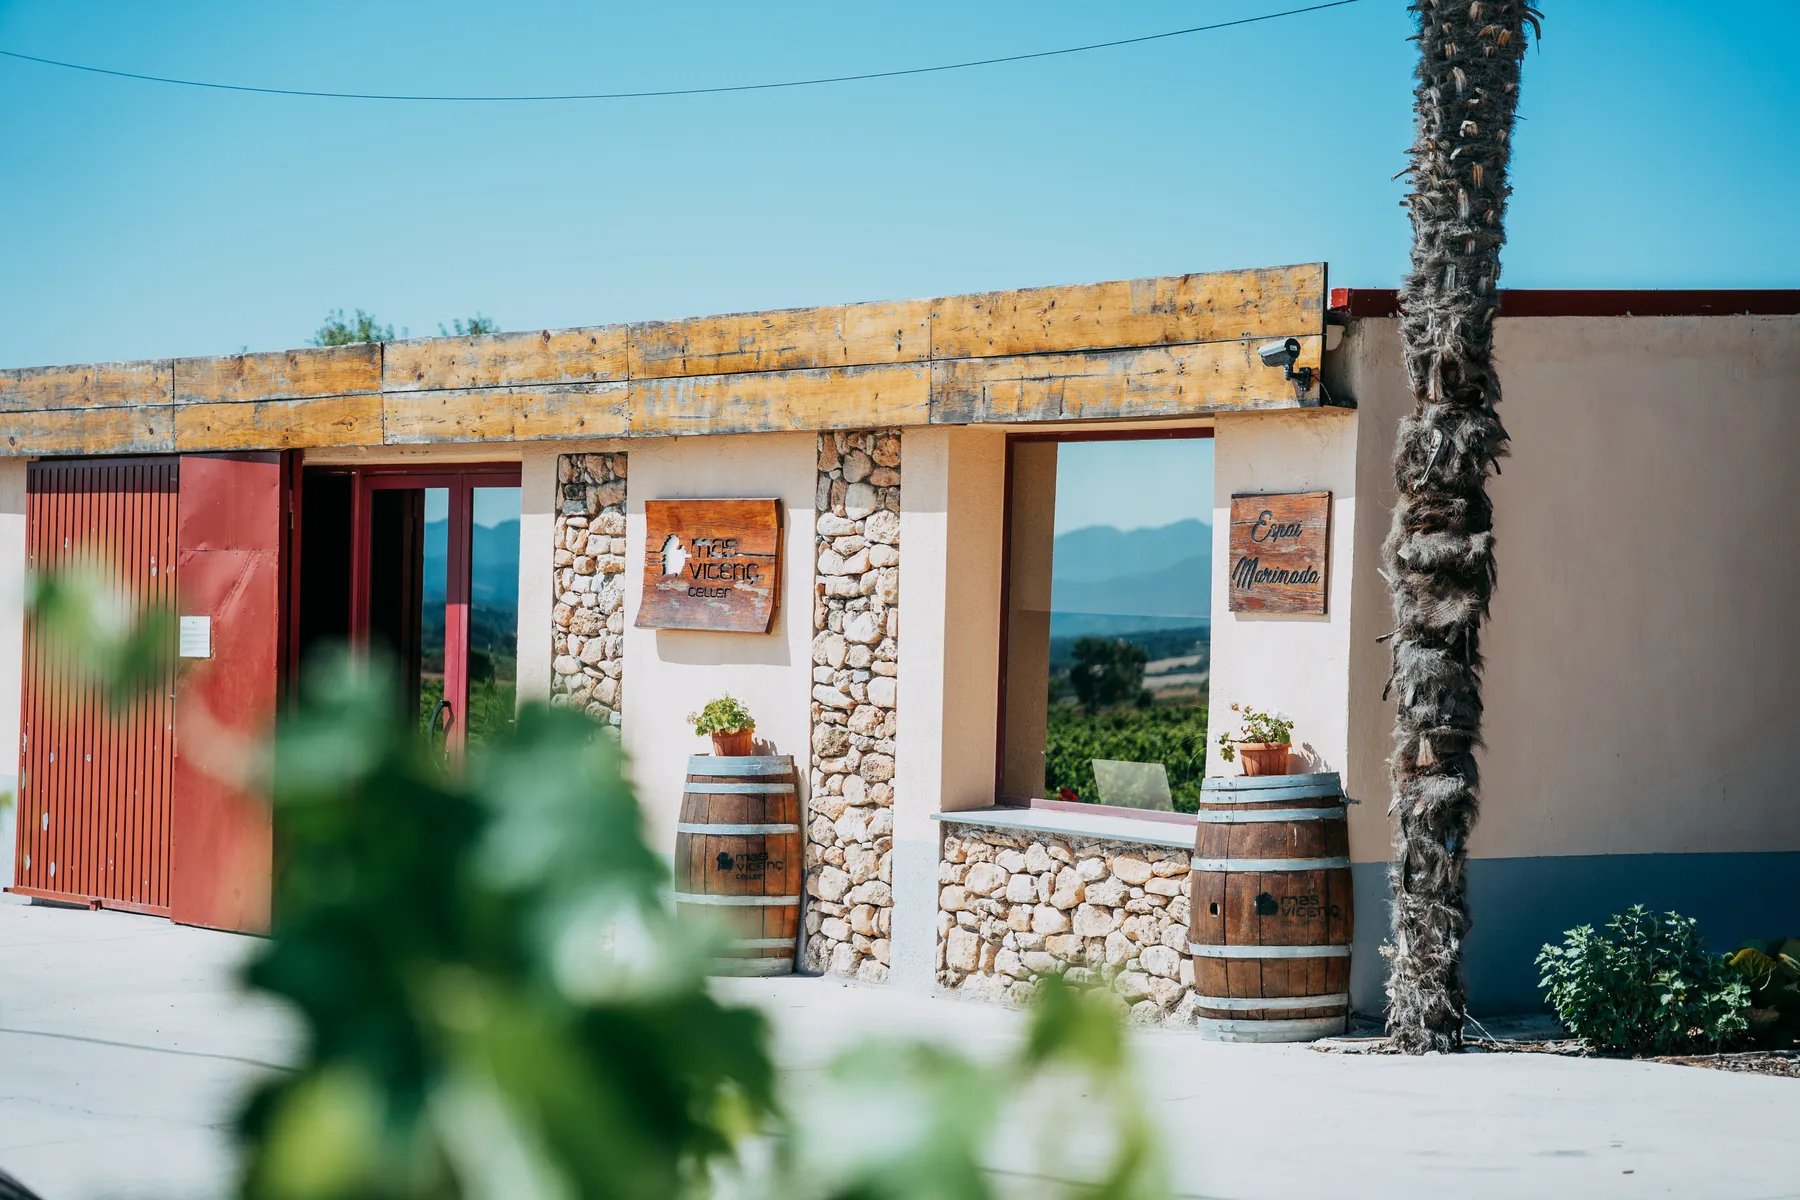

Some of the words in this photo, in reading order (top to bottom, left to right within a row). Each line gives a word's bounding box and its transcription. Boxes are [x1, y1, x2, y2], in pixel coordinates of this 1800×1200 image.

[1250, 509, 1303, 543] Espai
[691, 537, 738, 558] mas
[689, 562, 759, 585] vicenç
[1231, 556, 1321, 590] Marinada
[687, 586, 732, 598] celler
